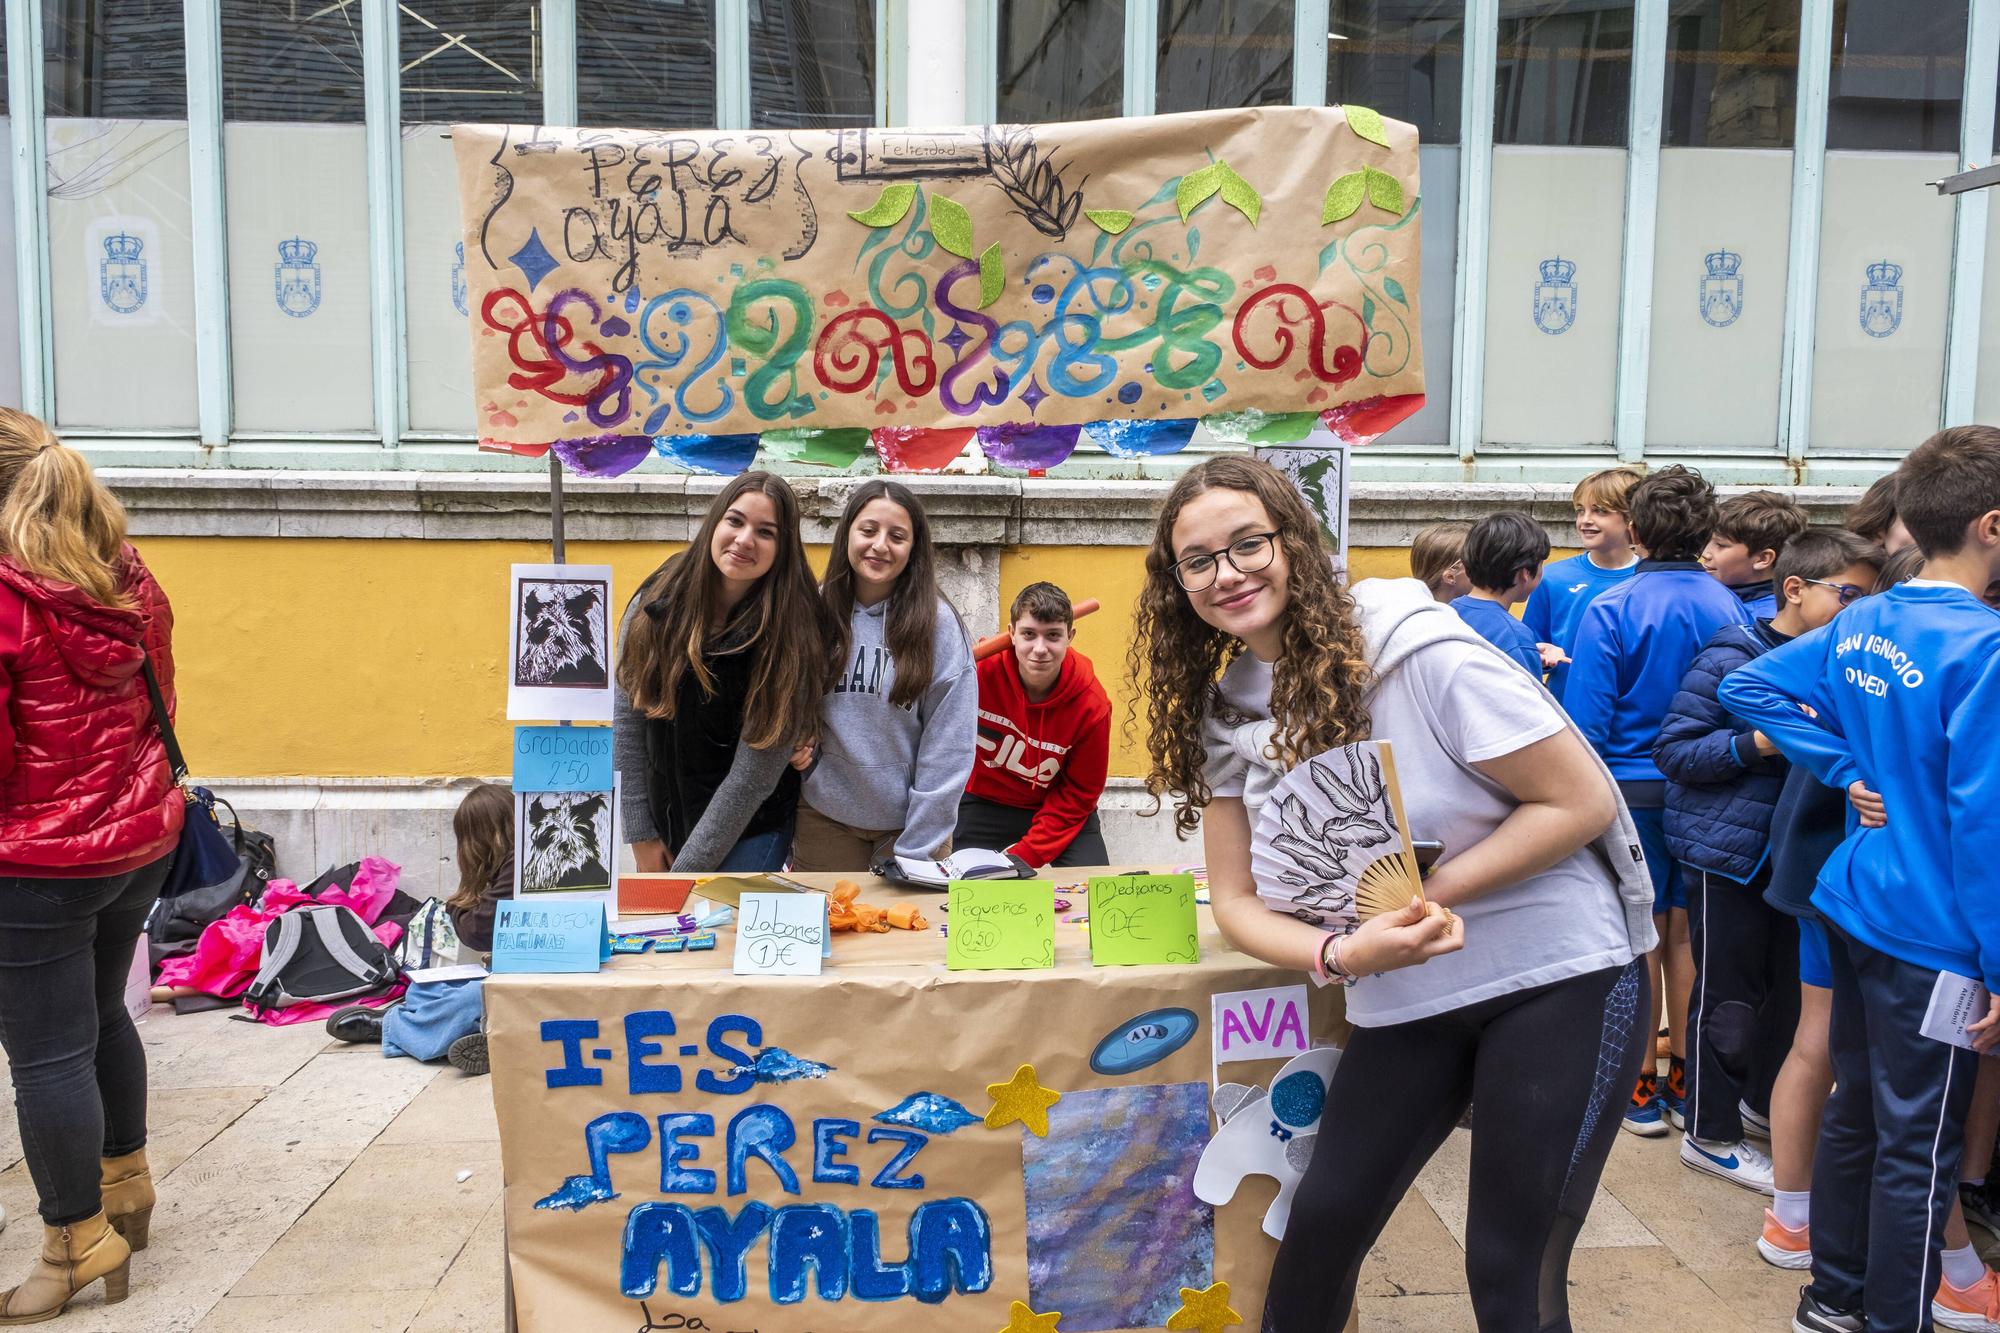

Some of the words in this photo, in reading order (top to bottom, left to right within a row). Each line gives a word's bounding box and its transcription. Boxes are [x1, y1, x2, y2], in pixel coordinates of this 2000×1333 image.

[881, 138, 956, 157] Felicidad
[1836, 633, 1863, 659] SAN
[1864, 634, 1925, 689] IGNACIO
[517, 730, 609, 756] Grabados
[500, 911, 549, 928] MARCA
[951, 887, 1027, 927] Pequeños
[1965, 983, 1980, 1011] Gracias
[1130, 1026, 1165, 1042] AVA
[1222, 997, 1307, 1051] AVA
[540, 1010, 763, 1095] I-E-S
[584, 1103, 930, 1196] PEREZ
[620, 1197, 995, 1304] AYALA
